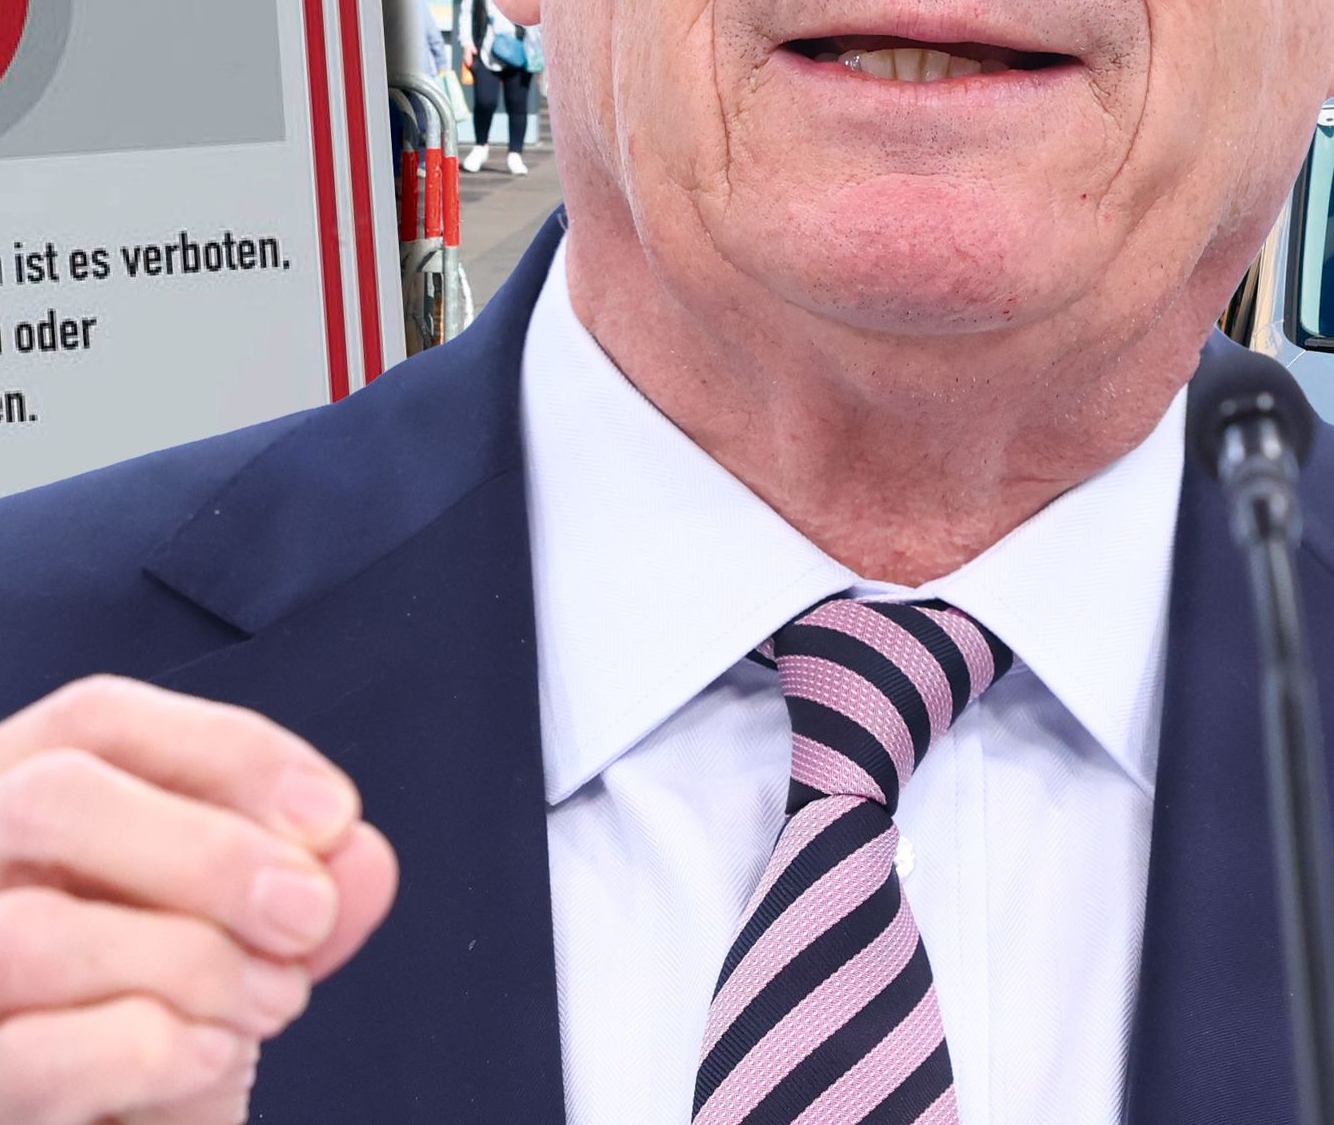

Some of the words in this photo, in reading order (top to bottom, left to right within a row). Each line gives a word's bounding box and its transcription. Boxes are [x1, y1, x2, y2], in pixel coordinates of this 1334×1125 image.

[14, 241, 59, 283] ist
[69, 246, 111, 281] es
[121, 230, 291, 277] verboten.
[16, 308, 97, 354] oder
